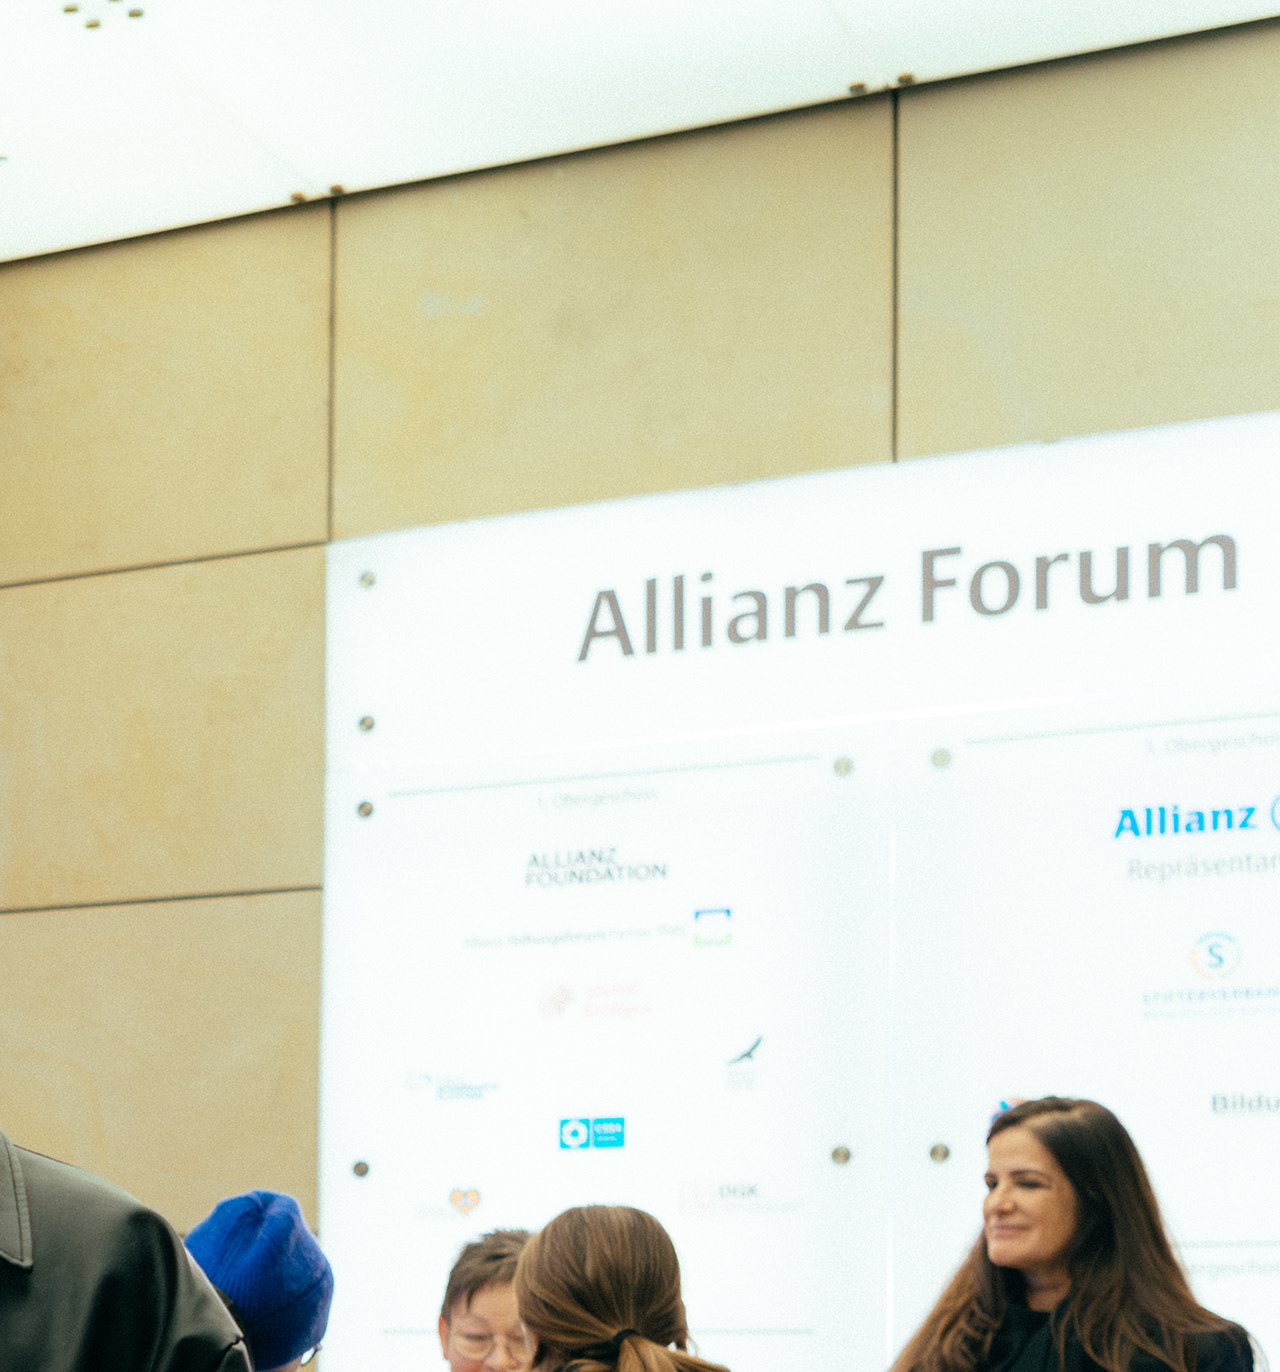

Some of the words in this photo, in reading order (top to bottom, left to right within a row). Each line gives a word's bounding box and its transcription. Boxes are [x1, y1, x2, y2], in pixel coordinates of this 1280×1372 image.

[576, 571, 886, 663] Allianz
[918, 529, 1240, 624] Forum
[1114, 804, 1258, 839] Allianz
[527, 846, 618, 869] ALLIANZ
[524, 863, 668, 888] FOUNDATION
